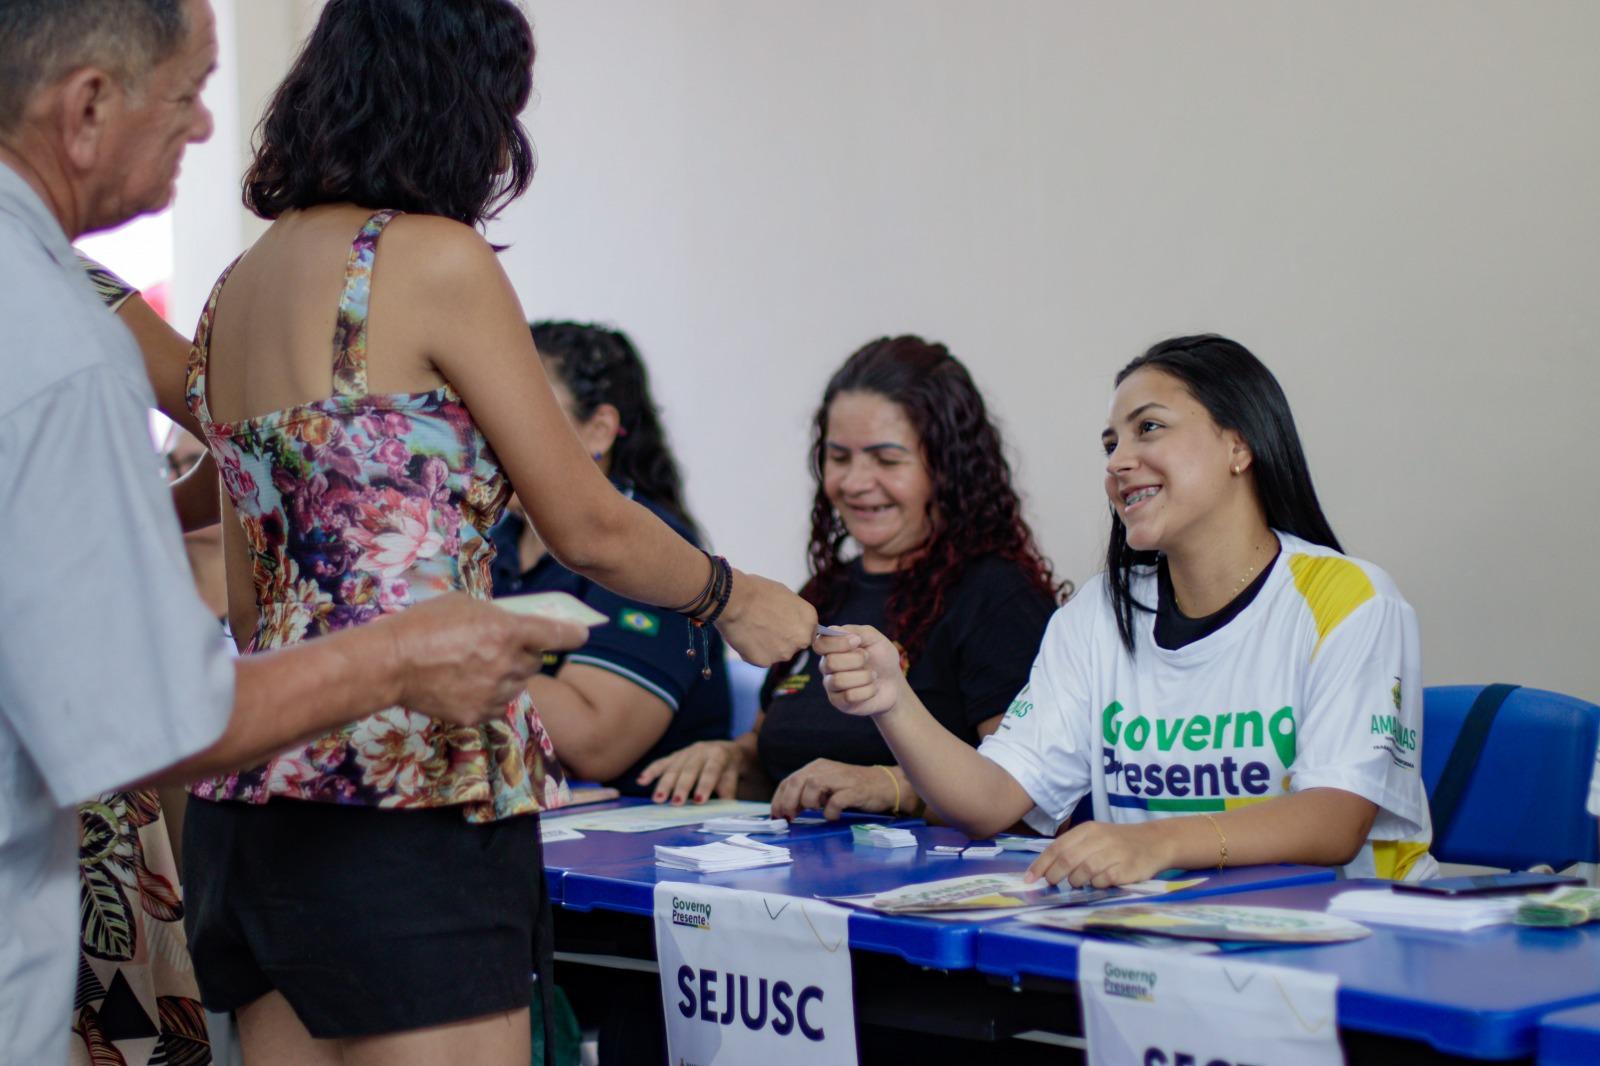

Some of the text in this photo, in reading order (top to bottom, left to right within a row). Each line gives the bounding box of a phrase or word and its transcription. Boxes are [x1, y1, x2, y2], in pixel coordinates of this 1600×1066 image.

[1102, 700, 1296, 769] Governo
[1371, 714, 1416, 751] AMAAS
[673, 896, 711, 920] Governo
[673, 909, 706, 925] Presente
[1104, 961, 1157, 988] Governo
[1104, 976, 1147, 996] Presente
[678, 965, 825, 1042] SEJUSC
